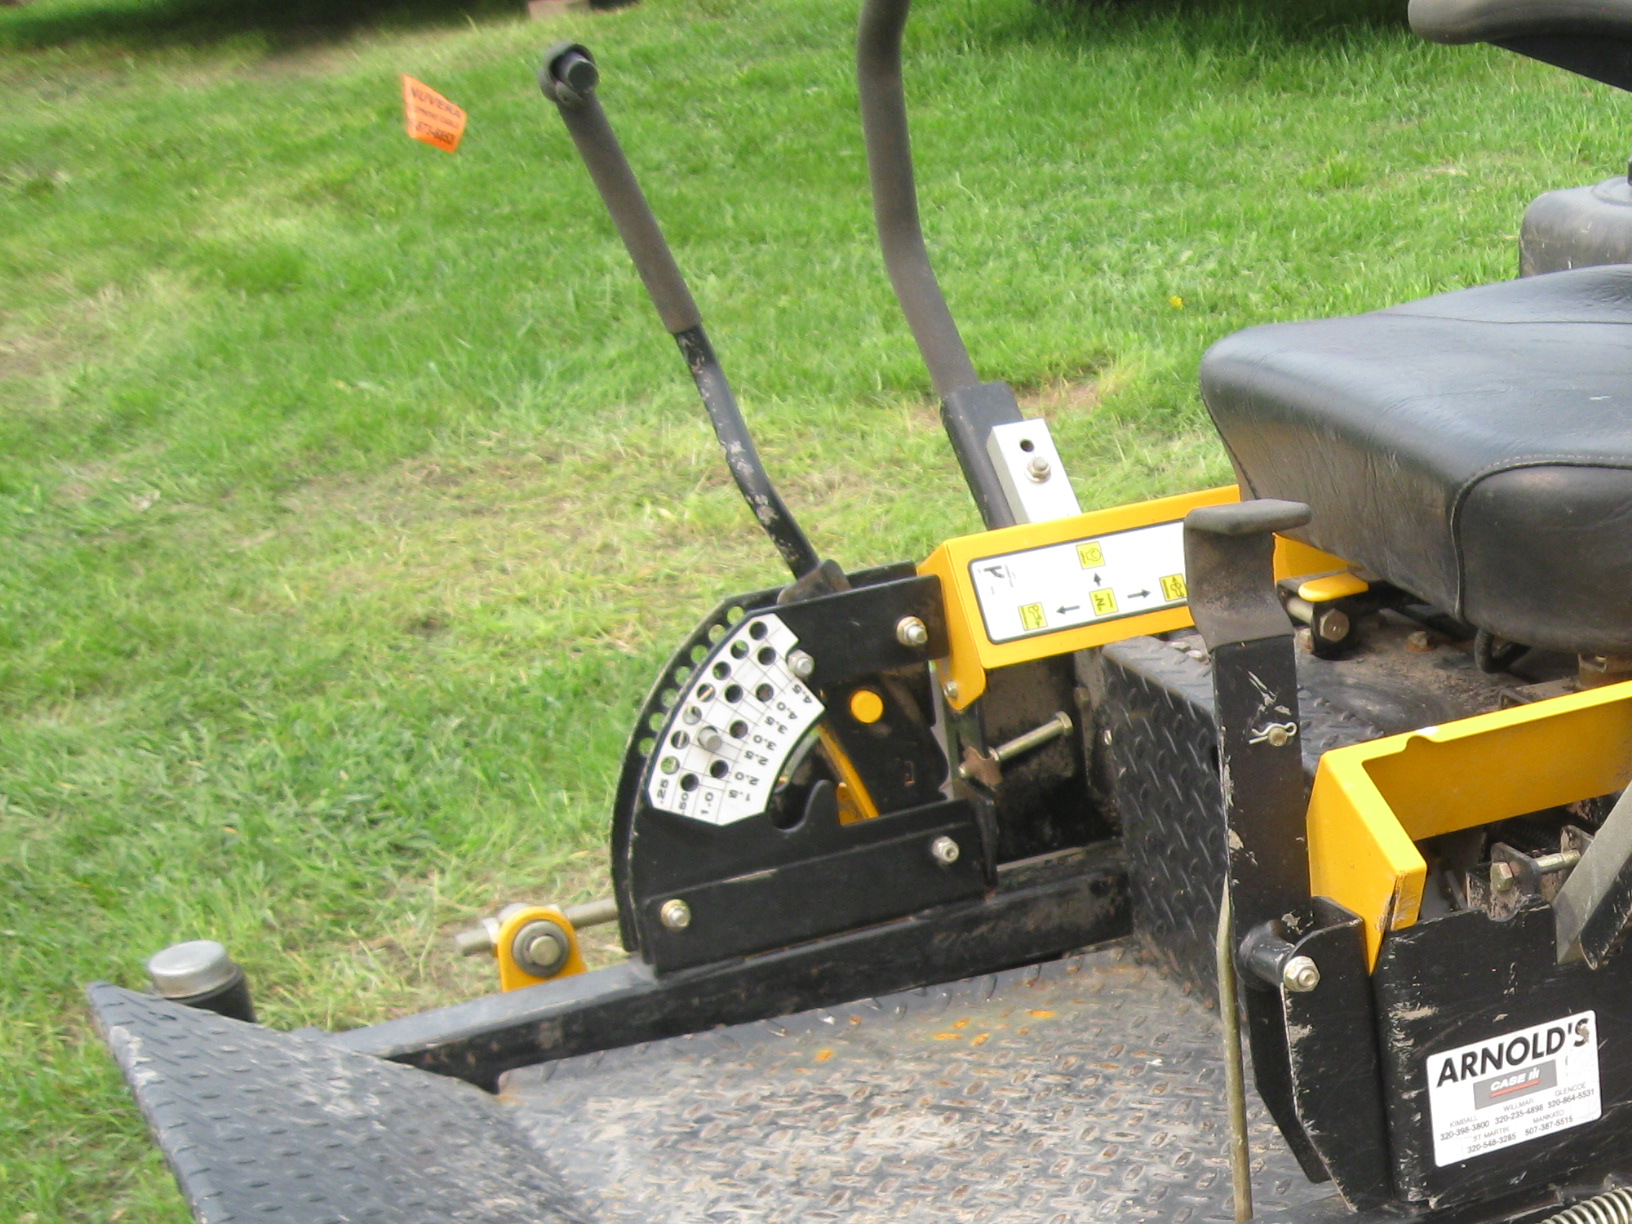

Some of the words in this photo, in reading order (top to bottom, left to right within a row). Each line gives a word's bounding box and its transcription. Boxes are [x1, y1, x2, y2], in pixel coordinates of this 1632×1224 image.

[791, 684, 814, 705] 4.5
[776, 702, 799, 720] 4.0
[764, 716, 788, 735] 3.5
[753, 734, 777, 751] 3.0
[743, 750, 769, 766] 2.5
[735, 771, 759, 786] 2.0
[699, 791, 715, 815] 1.0
[728, 788, 752, 802] 1.5
[1436, 1017, 1590, 1089] ARNOLD'S
[1489, 1073, 1527, 1092] CASE
